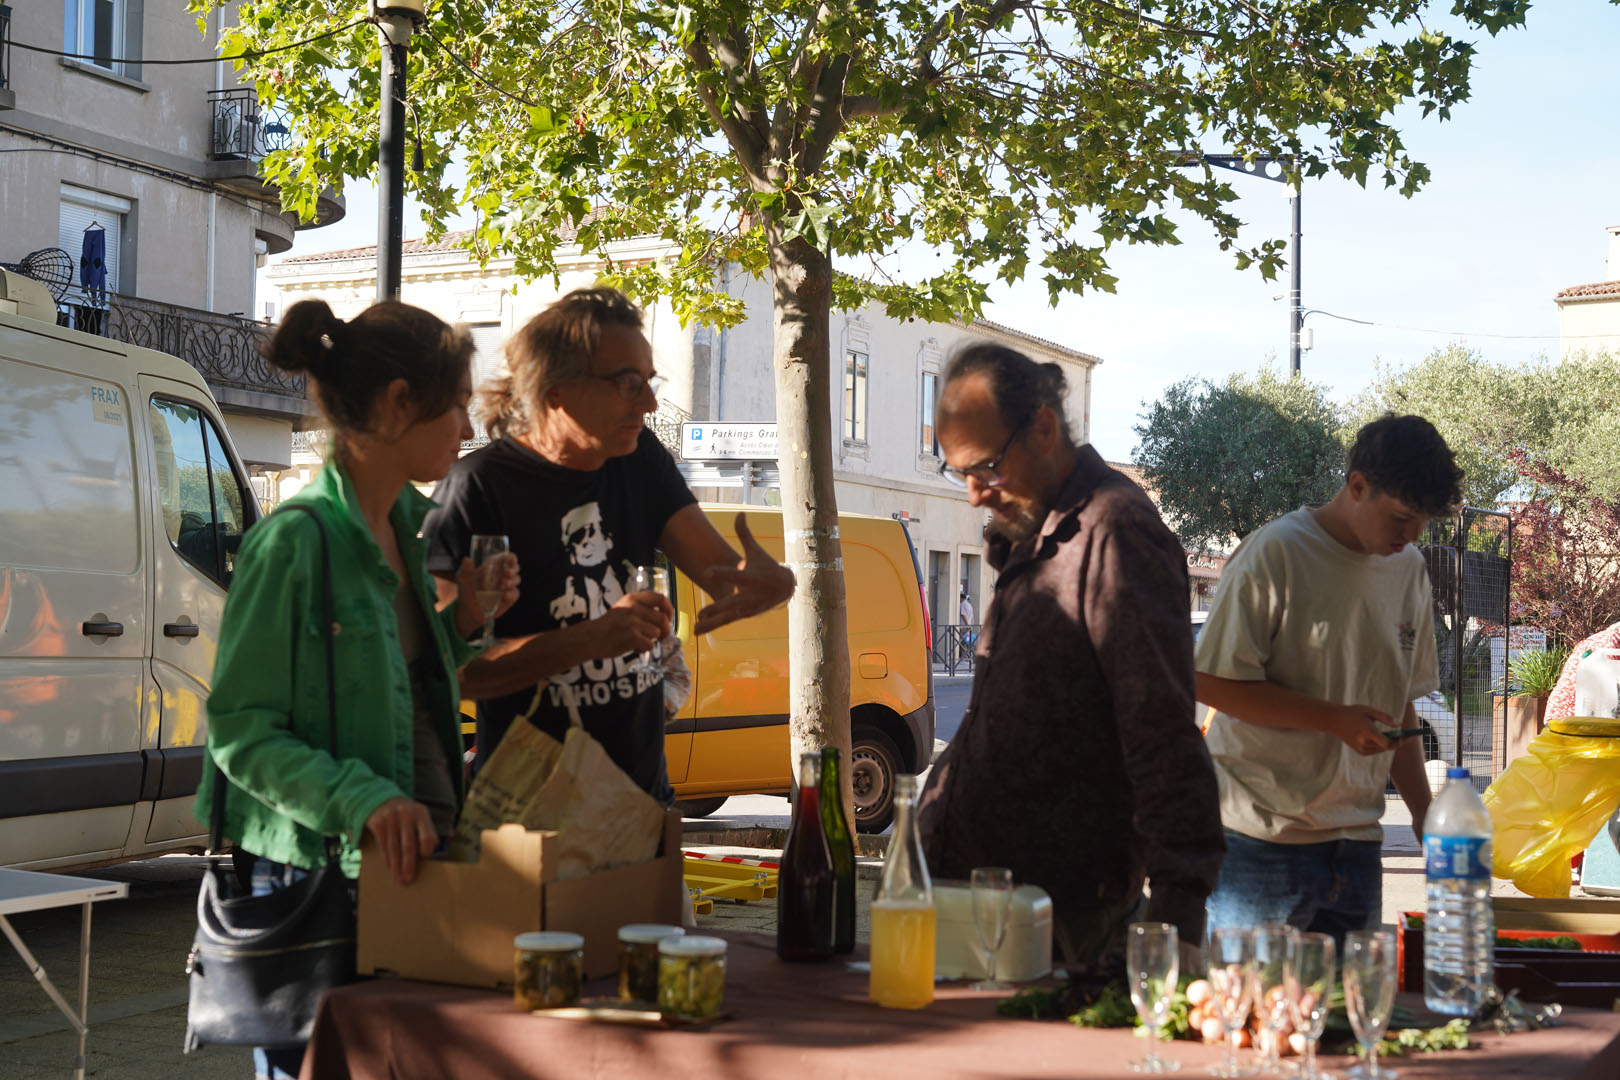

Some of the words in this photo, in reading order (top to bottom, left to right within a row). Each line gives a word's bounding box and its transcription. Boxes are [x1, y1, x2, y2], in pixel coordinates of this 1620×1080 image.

[91, 386, 119, 405] FRAX
[711, 429, 753, 440] Parkings
[548, 677, 635, 707] WHO'S
